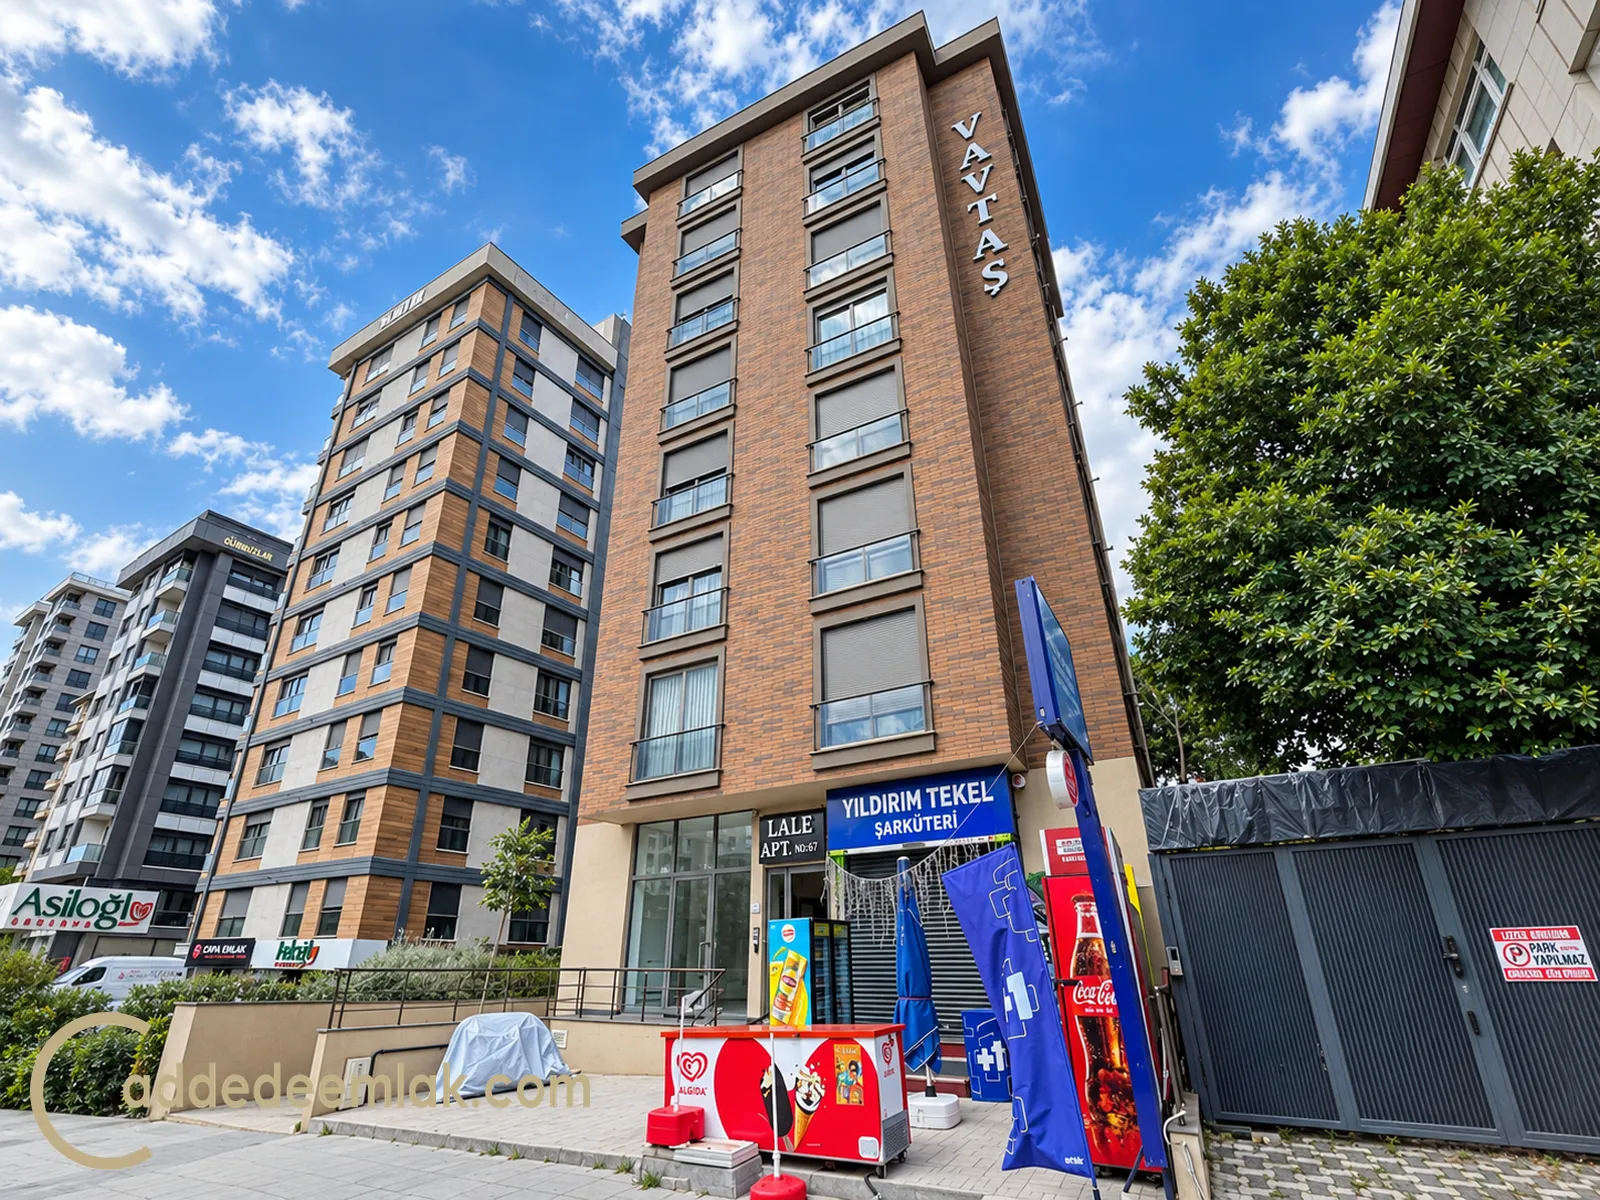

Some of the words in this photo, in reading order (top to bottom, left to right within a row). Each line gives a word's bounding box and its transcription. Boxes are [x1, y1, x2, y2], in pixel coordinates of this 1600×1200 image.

[951, 111, 1010, 299] VAVTAŞ
[842, 789, 923, 819] YILDIRIM
[925, 779, 995, 809] TEKEL
[767, 815, 813, 839] LALE
[874, 809, 959, 840] ŞARKÜTERİ
[760, 840, 792, 858] APT.
[794, 841, 818, 855] NO:67
[1528, 942, 1559, 954] PARK
[1532, 953, 1588, 966] YAPILMAZ
[1072, 979, 1117, 1006] Coca-Col
[678, 1086, 706, 1096] ALGIDA
